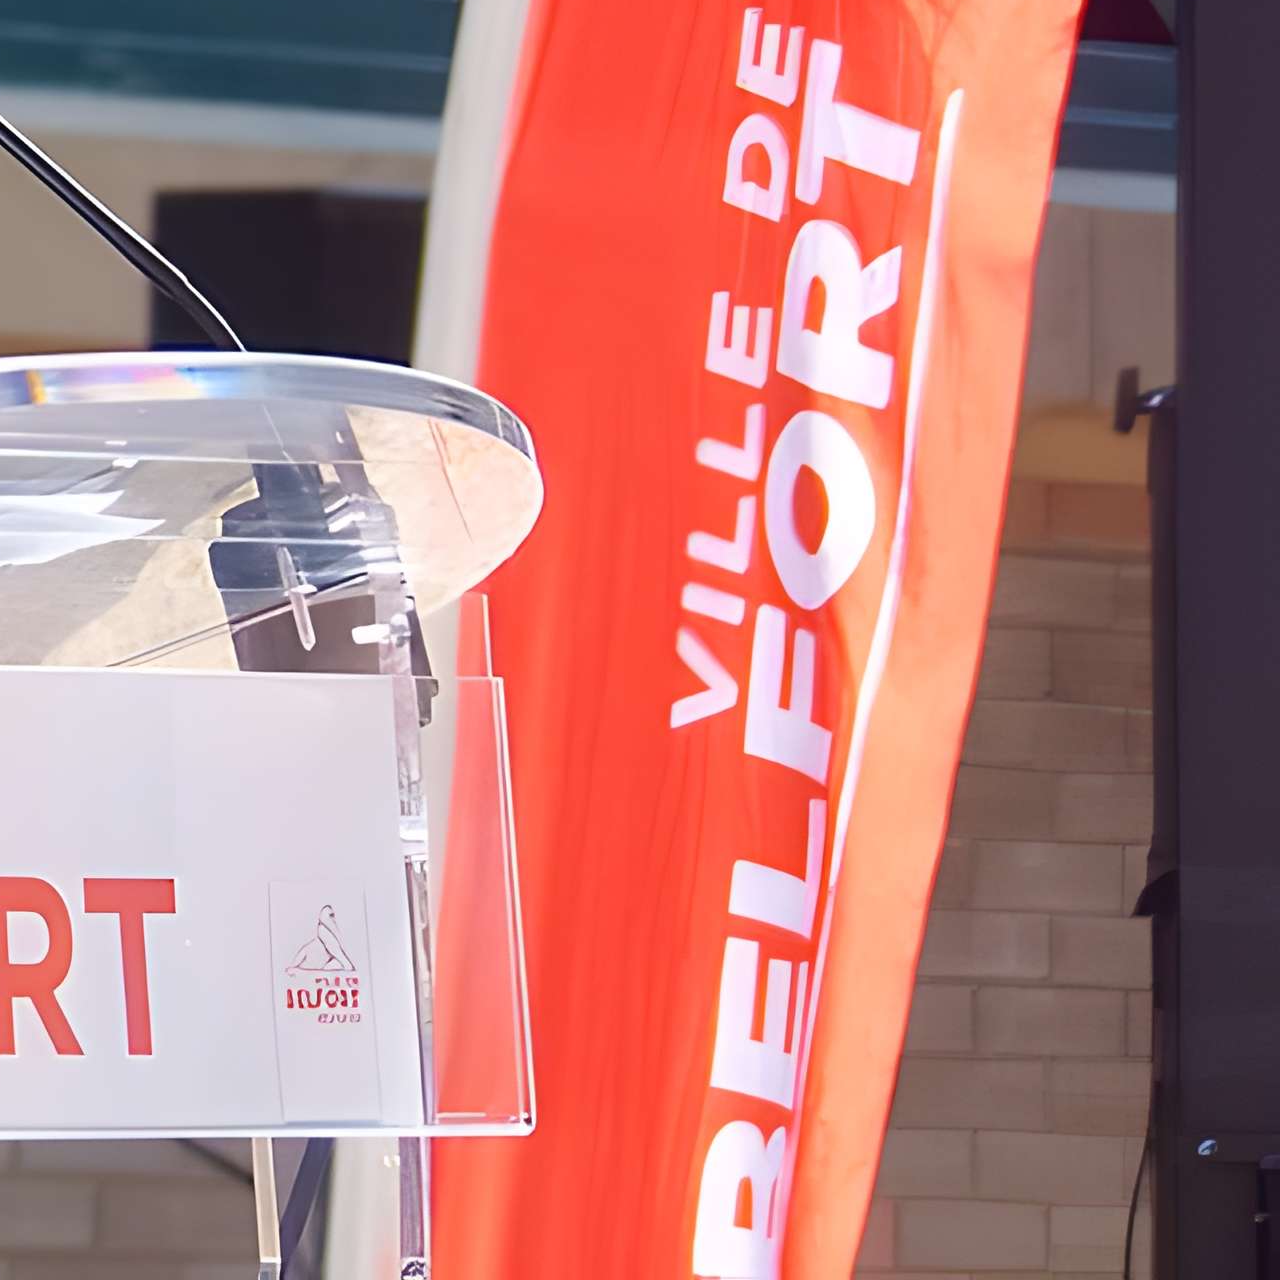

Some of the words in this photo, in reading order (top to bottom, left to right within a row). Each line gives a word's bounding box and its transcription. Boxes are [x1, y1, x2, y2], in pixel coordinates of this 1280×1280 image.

[670, 290, 774, 729] VILLE
[723, 6, 804, 223] DE
[692, 38, 922, 1280] BELFORT
